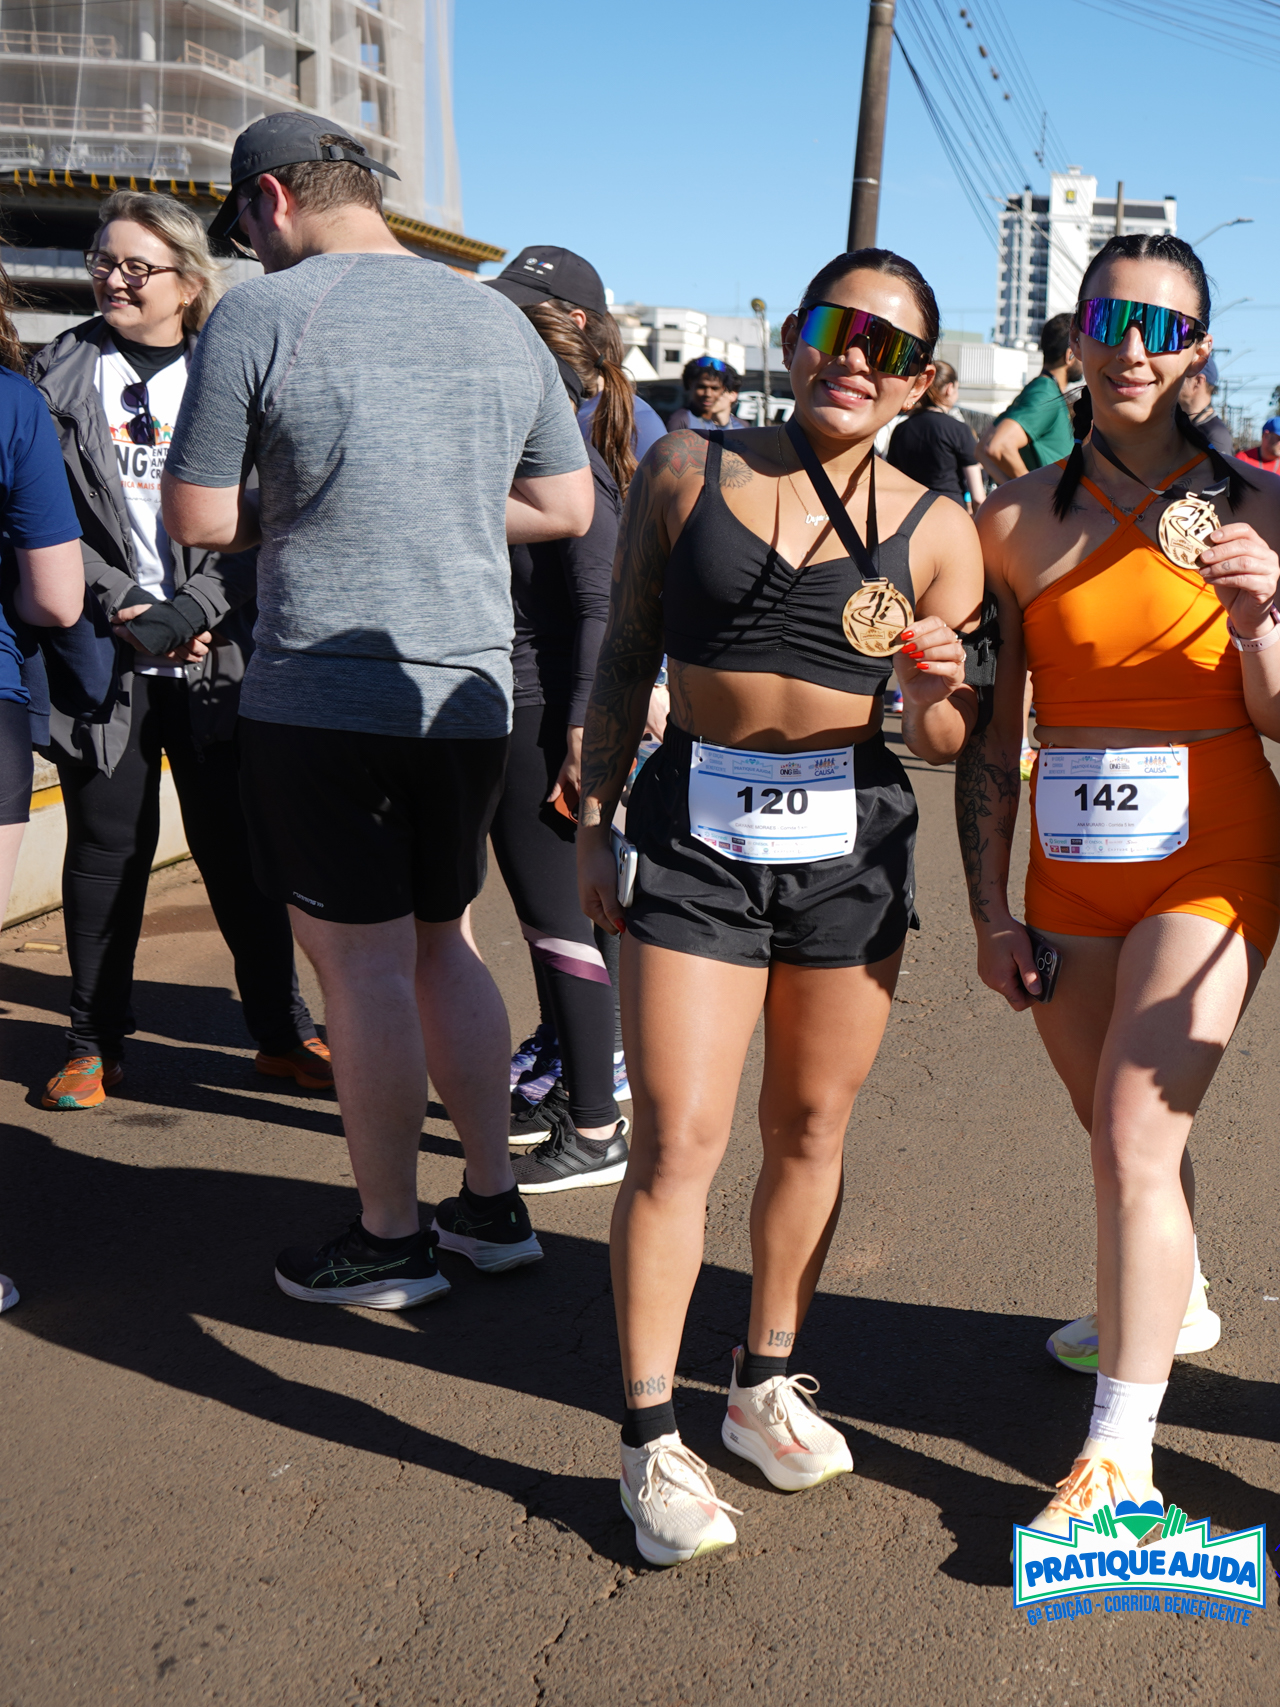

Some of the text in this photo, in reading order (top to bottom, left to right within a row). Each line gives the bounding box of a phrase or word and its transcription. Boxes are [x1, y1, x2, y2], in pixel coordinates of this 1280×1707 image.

[152, 448, 168, 457] ENT
[114, 445, 148, 478] NG
[151, 458, 165, 467] AM
[150, 468, 161, 479] CR
[137, 481, 155, 490] MAIS
[814, 769, 835, 777] CAUSA
[737, 786, 809, 815] 120
[1074, 783, 1139, 811] 142
[627, 1373, 667, 1398] 1986
